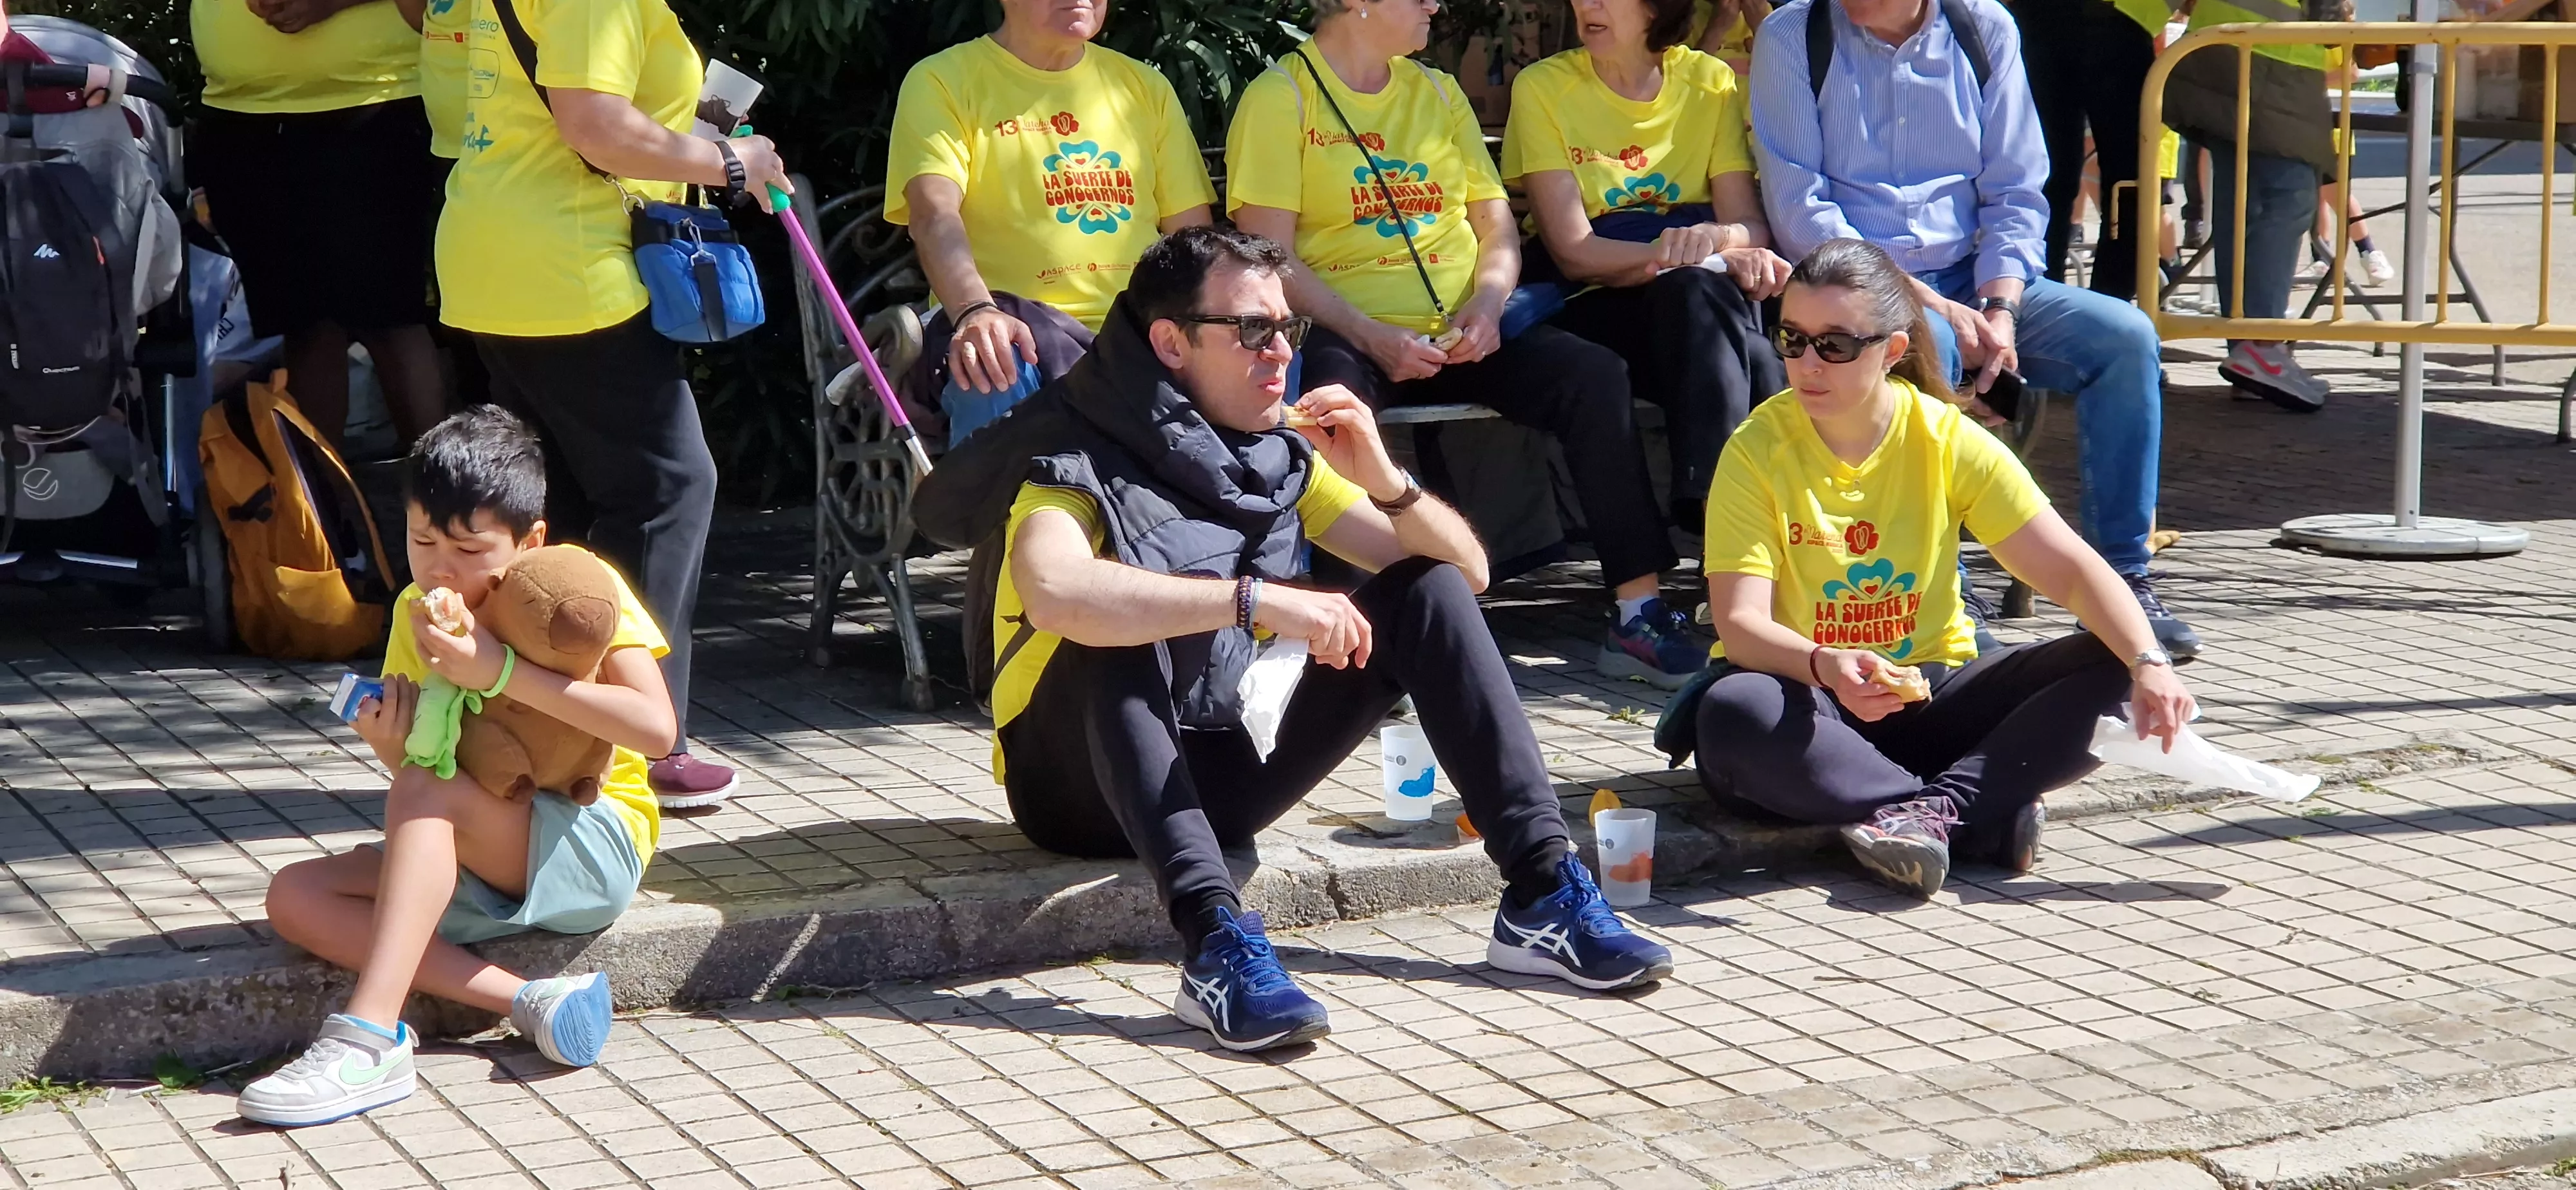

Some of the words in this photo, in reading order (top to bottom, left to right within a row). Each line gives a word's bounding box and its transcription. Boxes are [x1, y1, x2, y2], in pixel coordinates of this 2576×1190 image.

[995, 119, 1018, 137] 13
[1043, 173, 1061, 189] LA
[1063, 171, 1113, 187] SUERTE
[1115, 170, 1132, 187] DE
[1046, 187, 1134, 206] CONOCERNOS
[1350, 186, 1371, 205] LA
[1372, 184, 1425, 202] SERTE
[1423, 182, 1443, 196] DE
[1354, 196, 1443, 220] CONCERNOS
[1046, 263, 1081, 278] ASPACE
[1816, 601, 1837, 621] LA
[1842, 595, 1902, 623] SUERTE
[1907, 591, 1922, 614] DE
[1814, 611, 1917, 644] CONOCERNOS
